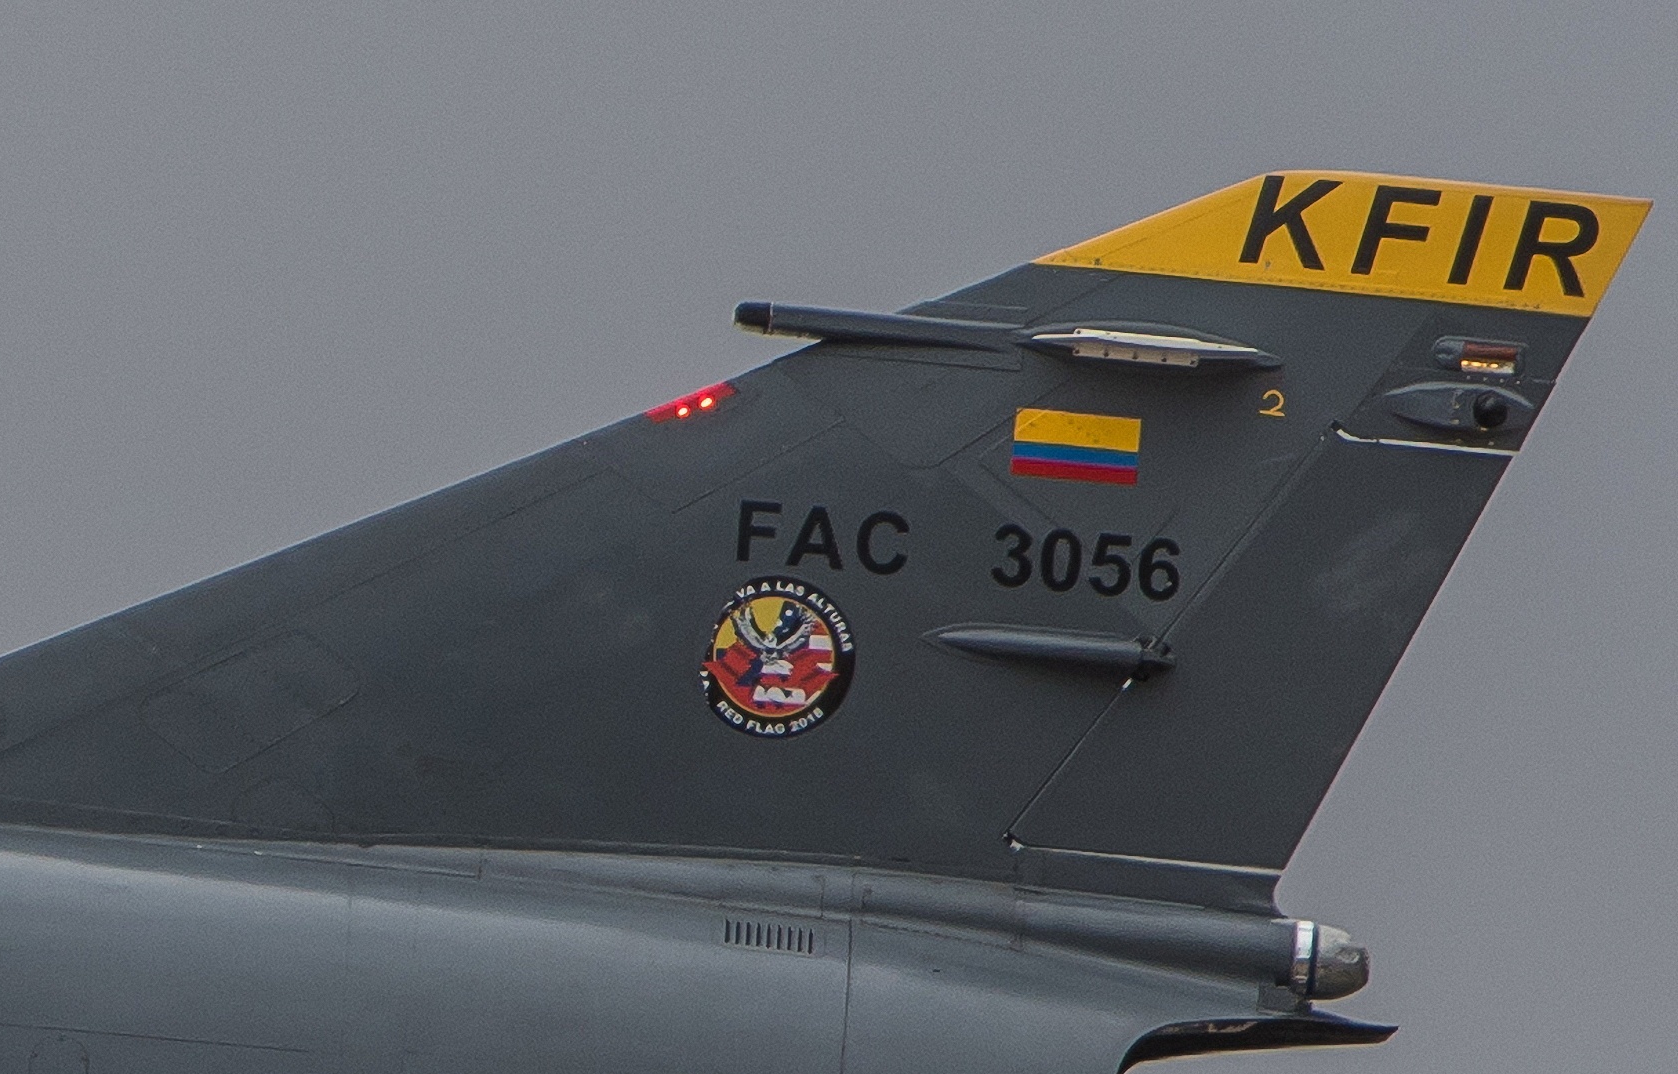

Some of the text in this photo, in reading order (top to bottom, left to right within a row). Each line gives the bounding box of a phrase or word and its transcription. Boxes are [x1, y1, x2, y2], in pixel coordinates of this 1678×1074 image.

[1239, 174, 1600, 298] KFIR
[1259, 389, 1286, 417] 2
[735, 499, 1181, 602] FAC 3056
[717, 700, 744, 724] RED
[746, 719, 786, 734] FLAG
